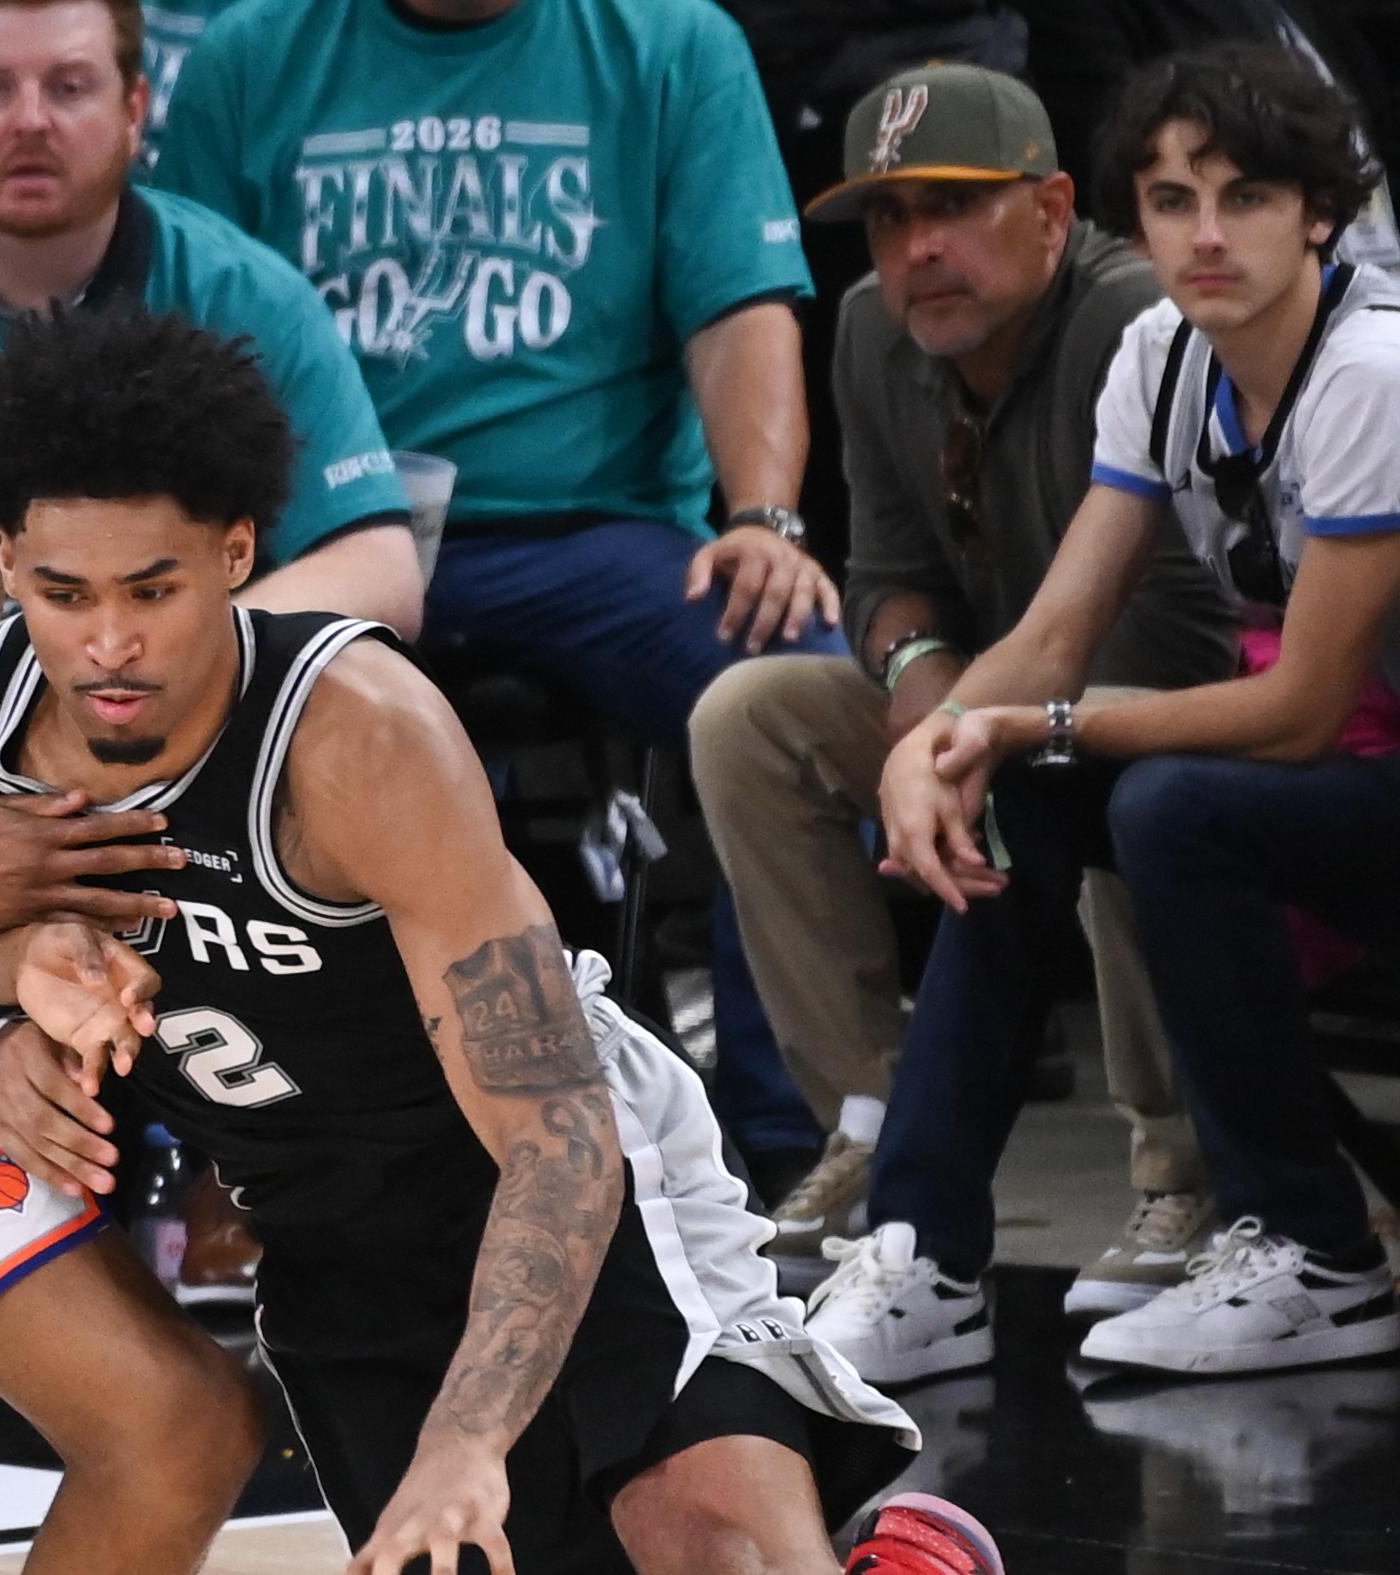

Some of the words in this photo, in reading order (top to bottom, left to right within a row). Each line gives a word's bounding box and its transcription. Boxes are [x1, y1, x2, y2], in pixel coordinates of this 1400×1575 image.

[391, 115, 502, 151] 2026
[296, 154, 598, 277] FINALS
[464, 256, 573, 361] GO
[184, 848, 232, 873] EDGER
[154, 1005, 303, 1109] 2
